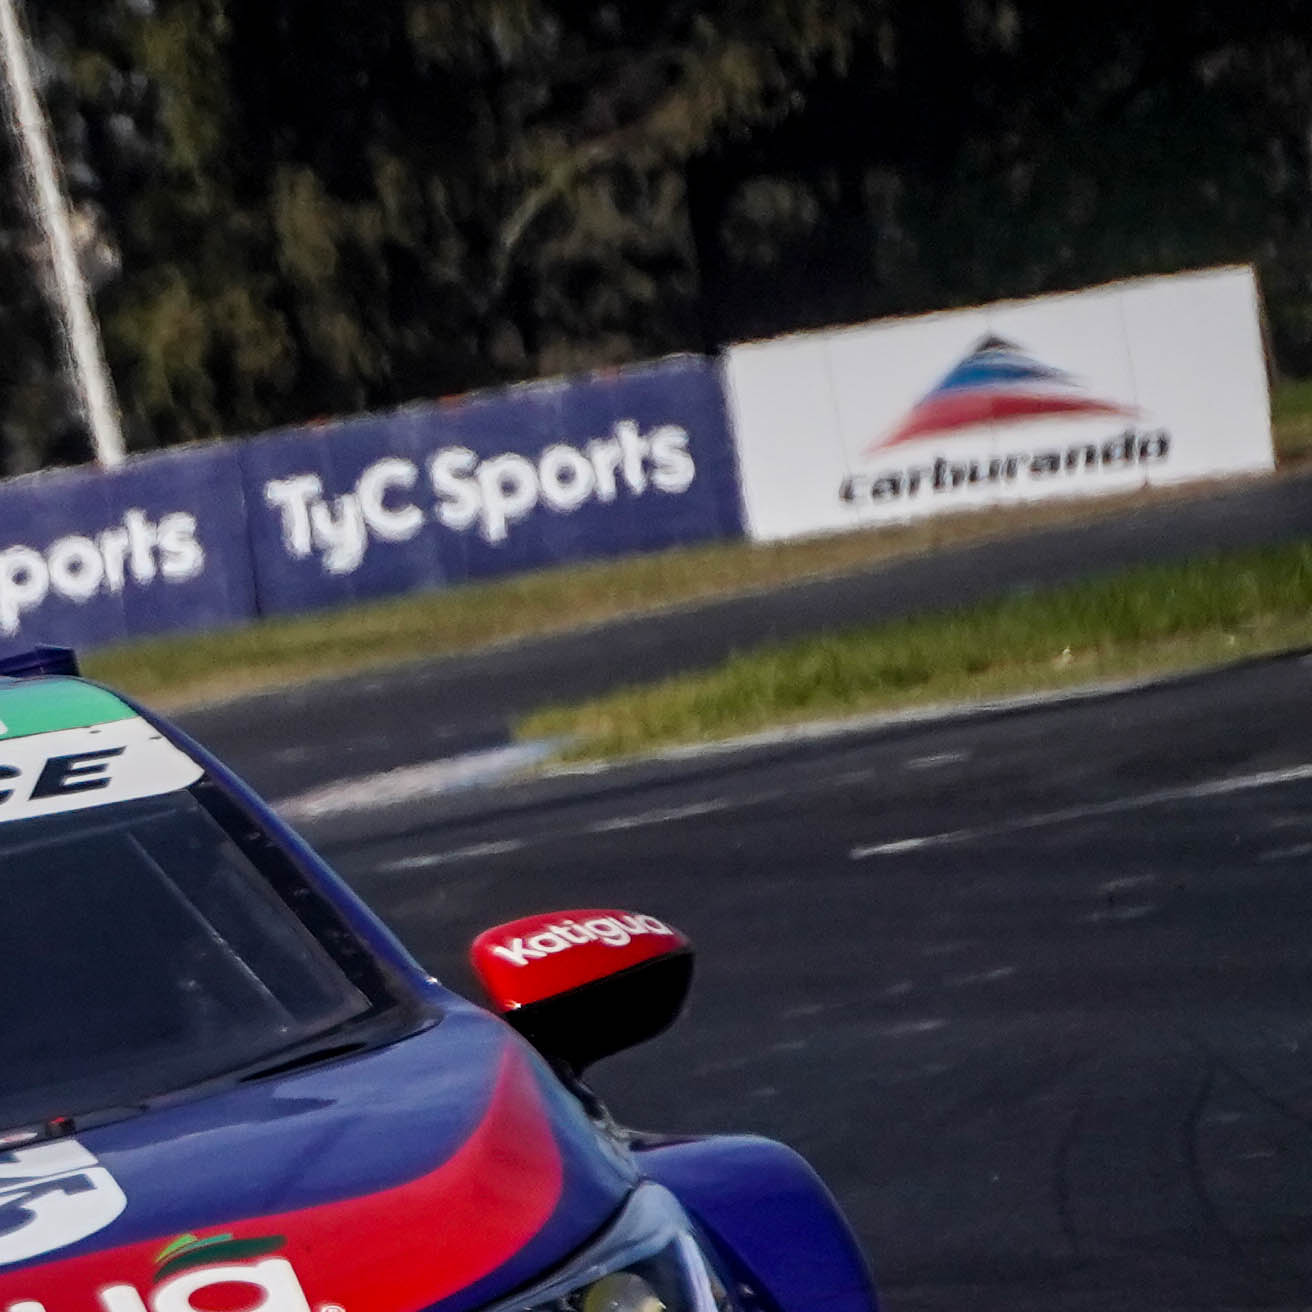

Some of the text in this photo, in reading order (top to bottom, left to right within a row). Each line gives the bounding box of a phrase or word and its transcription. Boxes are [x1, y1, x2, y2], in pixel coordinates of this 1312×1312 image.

[264, 420, 696, 576] TyC Sports
[839, 428, 1172, 503] carburando
